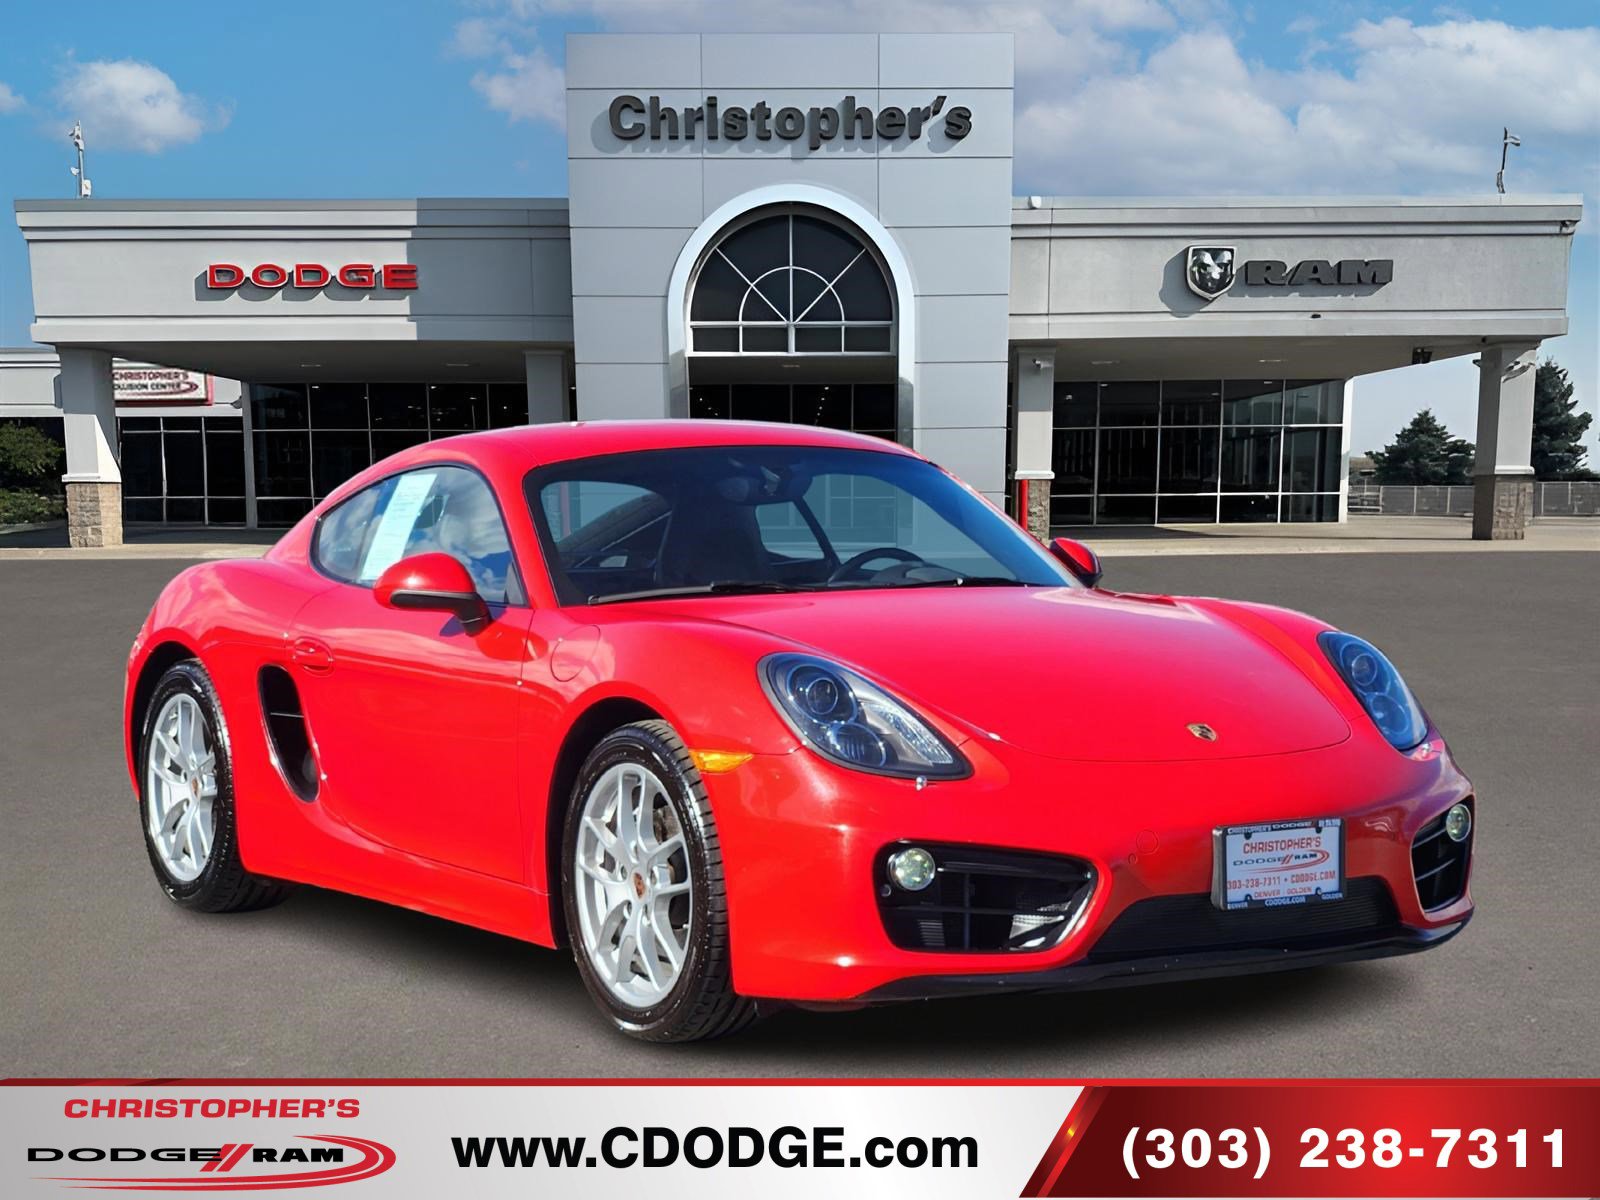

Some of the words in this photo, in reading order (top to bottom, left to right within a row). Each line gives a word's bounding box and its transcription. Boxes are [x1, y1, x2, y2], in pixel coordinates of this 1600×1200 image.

[608, 94, 973, 151] Christopher's
[206, 263, 418, 290] DODGE
[1245, 259, 1394, 286] RAM
[113, 382, 148, 391] OLLISION
[1243, 837, 1322, 855] CHRISTOPHER'S
[1233, 857, 1284, 866] DODGE
[1227, 876, 1281, 890] 303-238-7311
